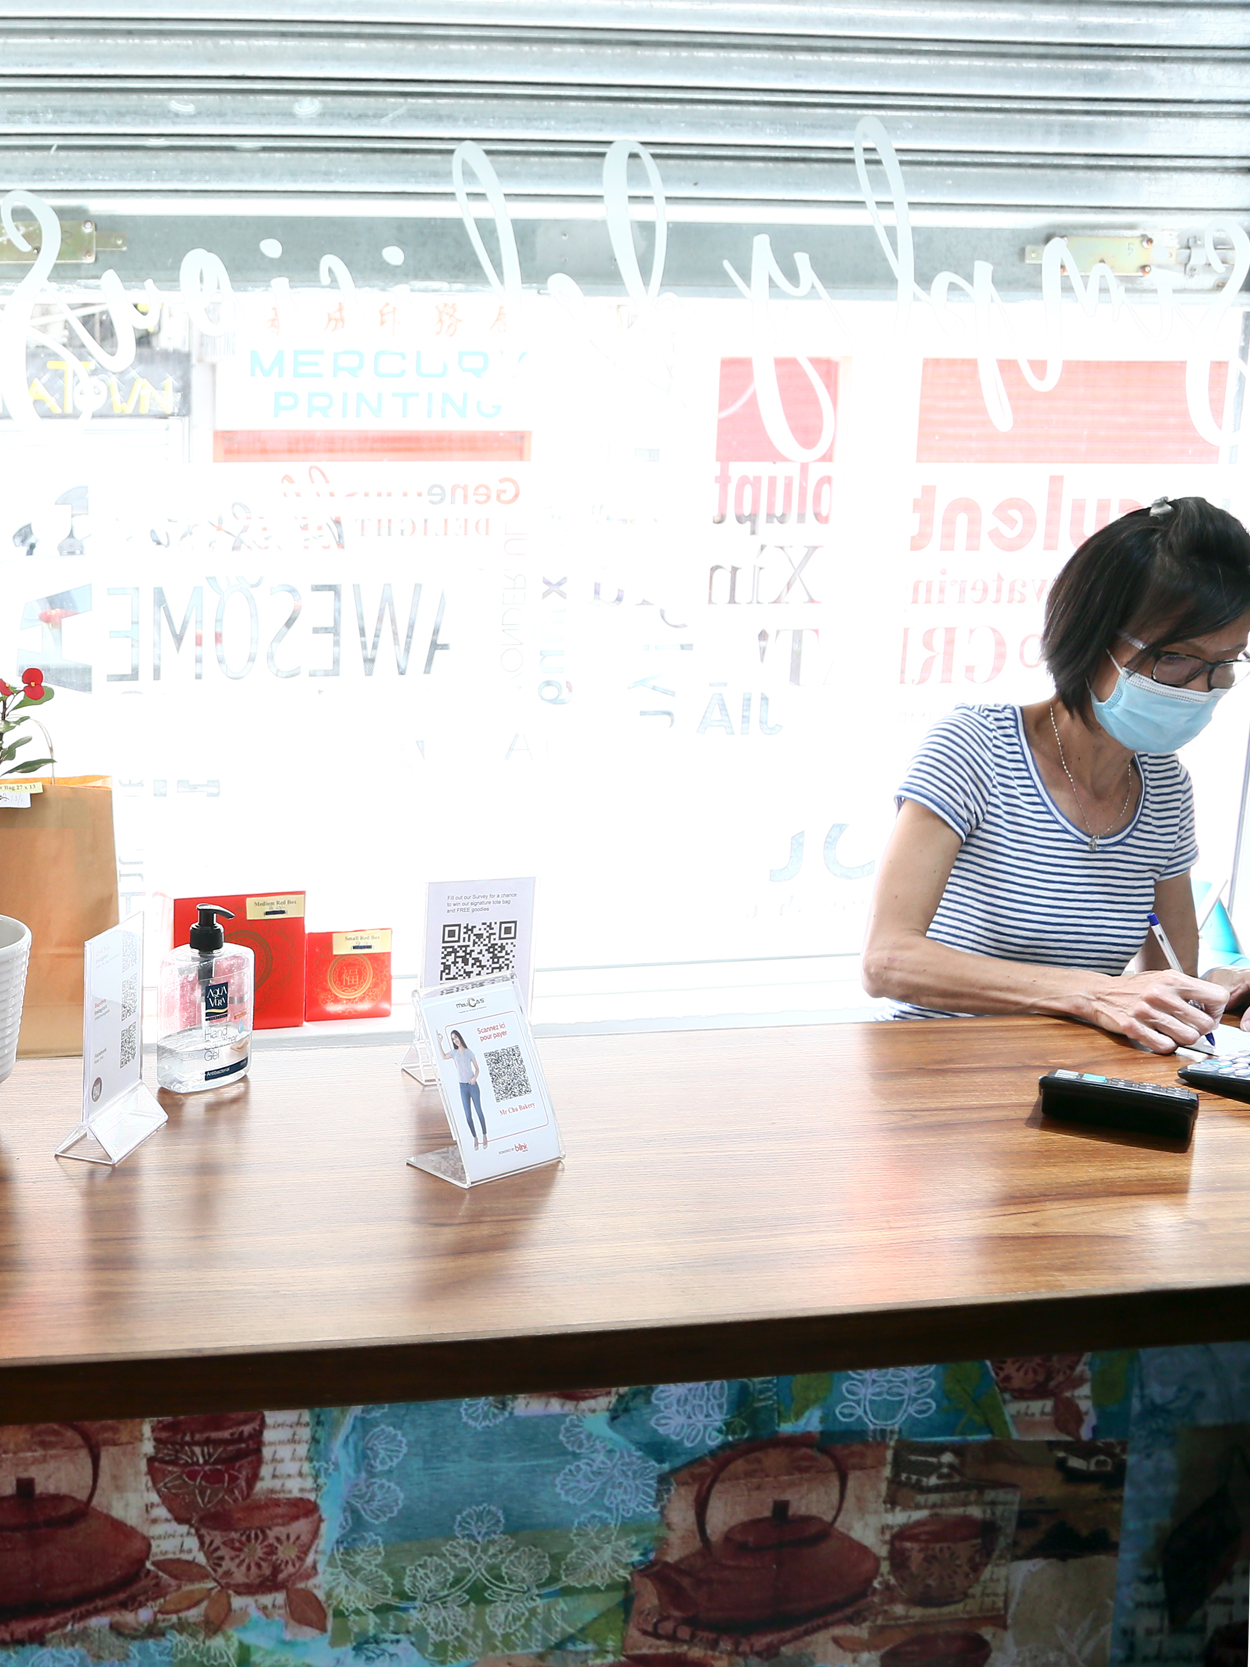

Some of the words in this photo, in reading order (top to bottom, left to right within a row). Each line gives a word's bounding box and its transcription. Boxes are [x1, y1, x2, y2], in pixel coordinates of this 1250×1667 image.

[274, 391, 503, 419] PRINTING
[206, 985, 228, 998] AQUA
[205, 1026, 228, 1039] Hand
[477, 1024, 499, 1035] Scannez
[480, 1033, 493, 1042] pour
[493, 1030, 508, 1040] payer
[204, 1050, 220, 1061] Gel
[207, 1067, 230, 1077] Antibacterial
[508, 1106, 518, 1114] Chu
[519, 1102, 536, 1112] Bakery
